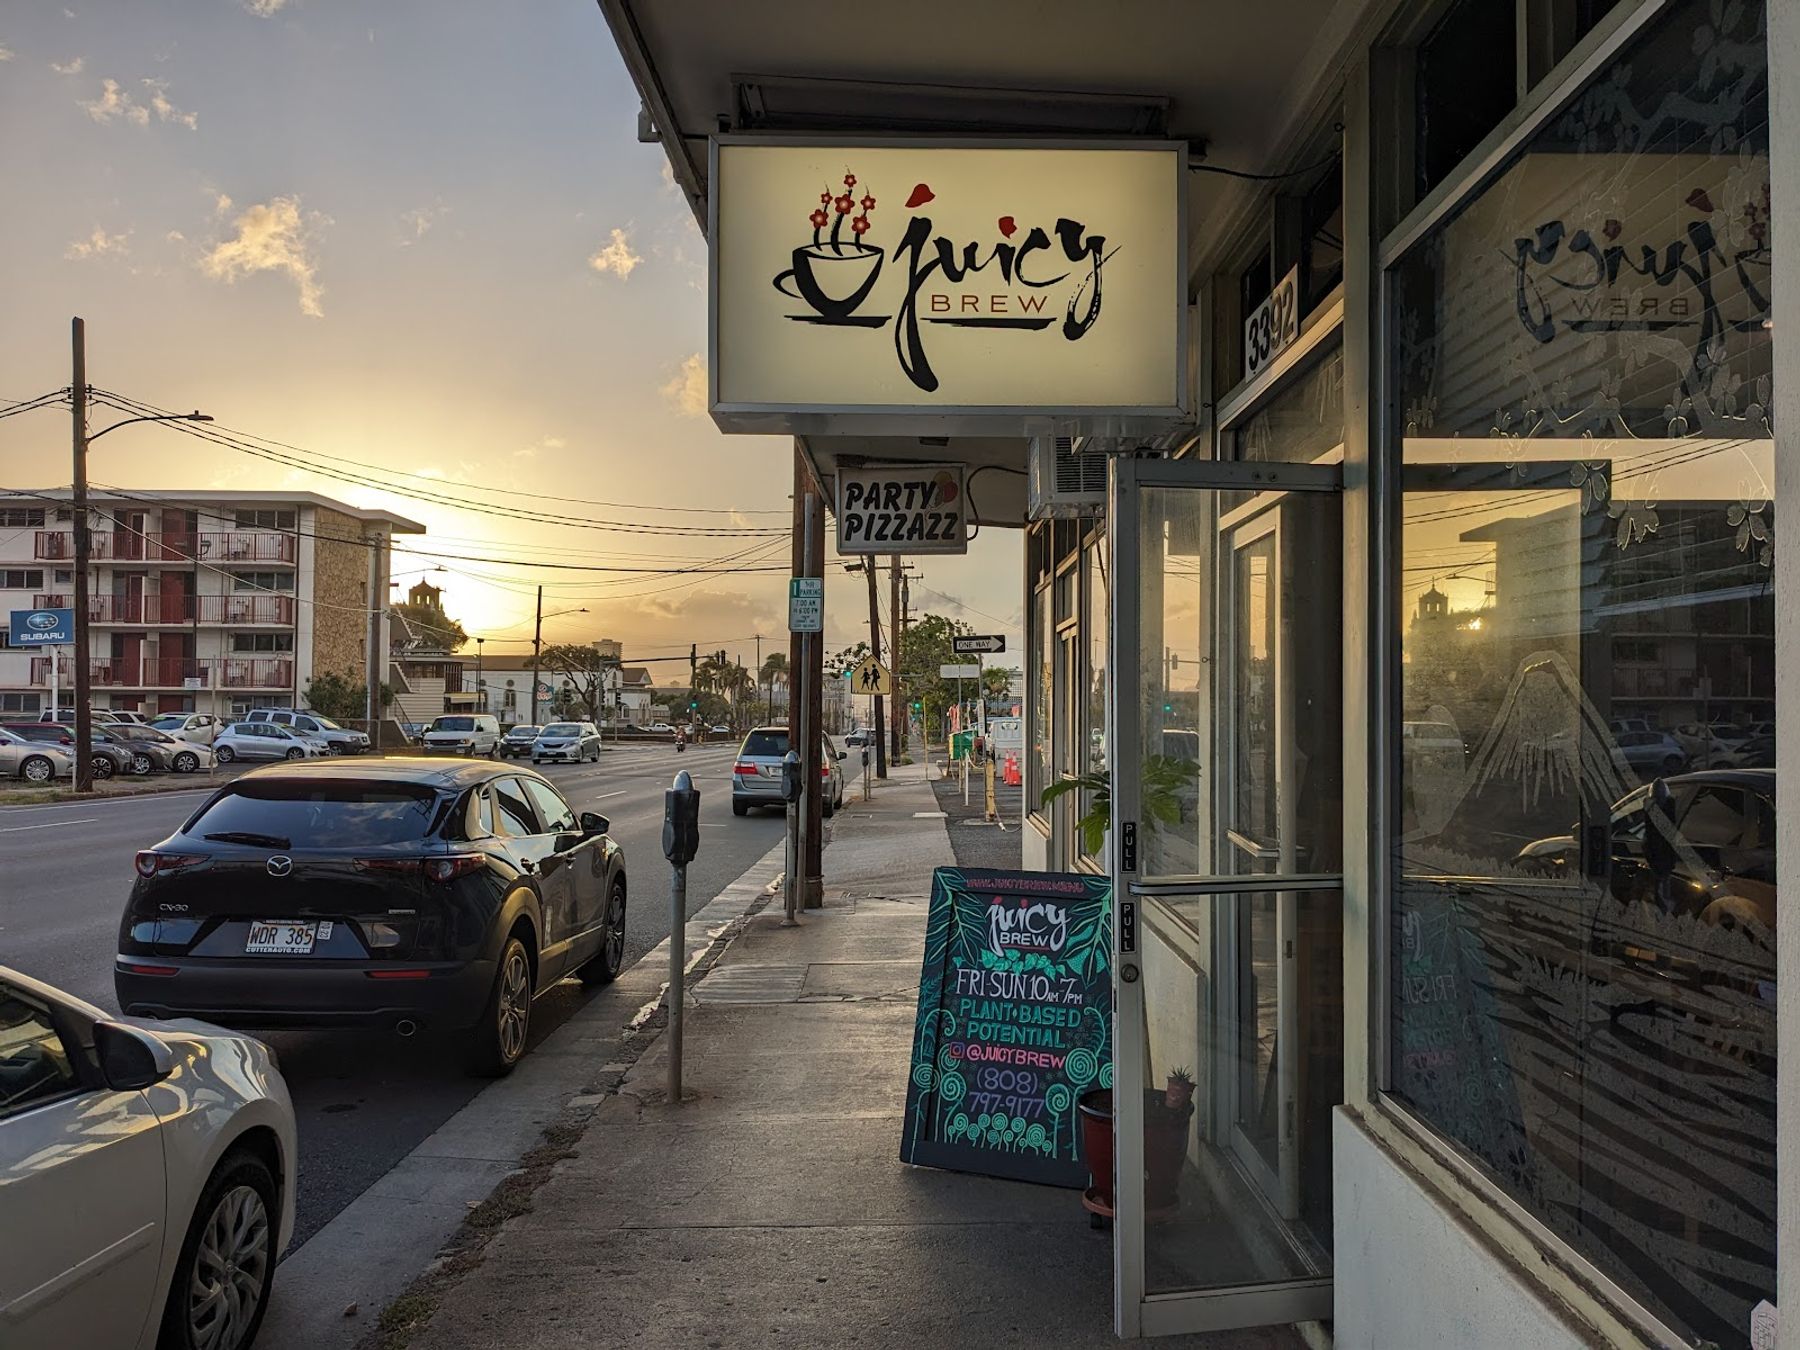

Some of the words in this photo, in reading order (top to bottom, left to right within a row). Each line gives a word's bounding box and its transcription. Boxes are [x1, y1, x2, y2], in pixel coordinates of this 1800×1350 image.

[893, 184, 1122, 392] juicy
[931, 294, 1048, 313] BREW
[1248, 281, 1294, 371] 3392
[845, 481, 937, 512] PARTY
[844, 512, 958, 541] PIZZAZZ
[20, 632, 65, 641] SUBARU
[959, 641, 973, 649] ONE
[975, 640, 990, 648] WAY
[1125, 824, 1133, 870] PULL
[160, 903, 188, 912] CX-30
[250, 926, 278, 945] WDR
[285, 927, 314, 946] 385
[1000, 931, 1049, 947] BREW
[1123, 904, 1132, 950] PULL
[966, 1021, 1066, 1049] POTENTIAL
[976, 1066, 1038, 1094] (808)
[968, 1090, 1047, 1118] 797-9177
